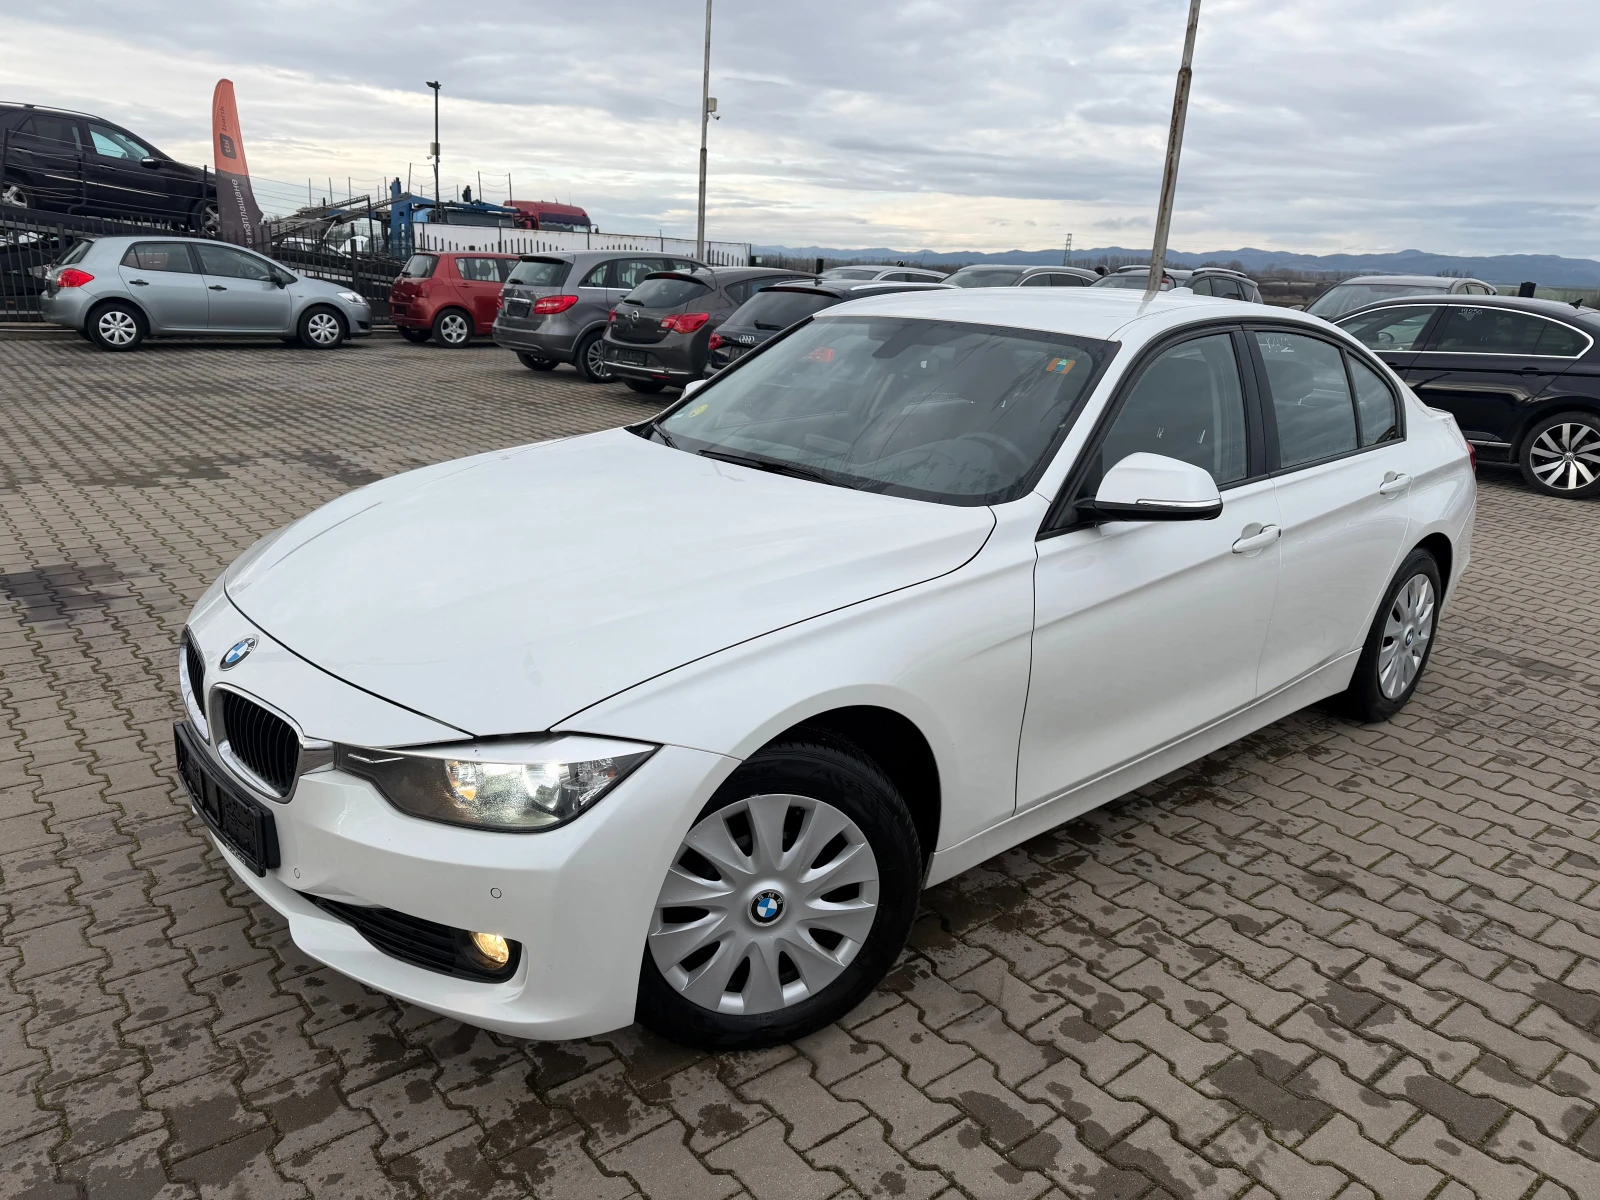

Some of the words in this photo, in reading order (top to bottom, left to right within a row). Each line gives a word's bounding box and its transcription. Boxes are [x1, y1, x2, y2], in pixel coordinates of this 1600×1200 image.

[223, 139, 231, 153] tbi
[231, 178, 252, 236] изплащане
[758, 892, 783, 905] BMW
